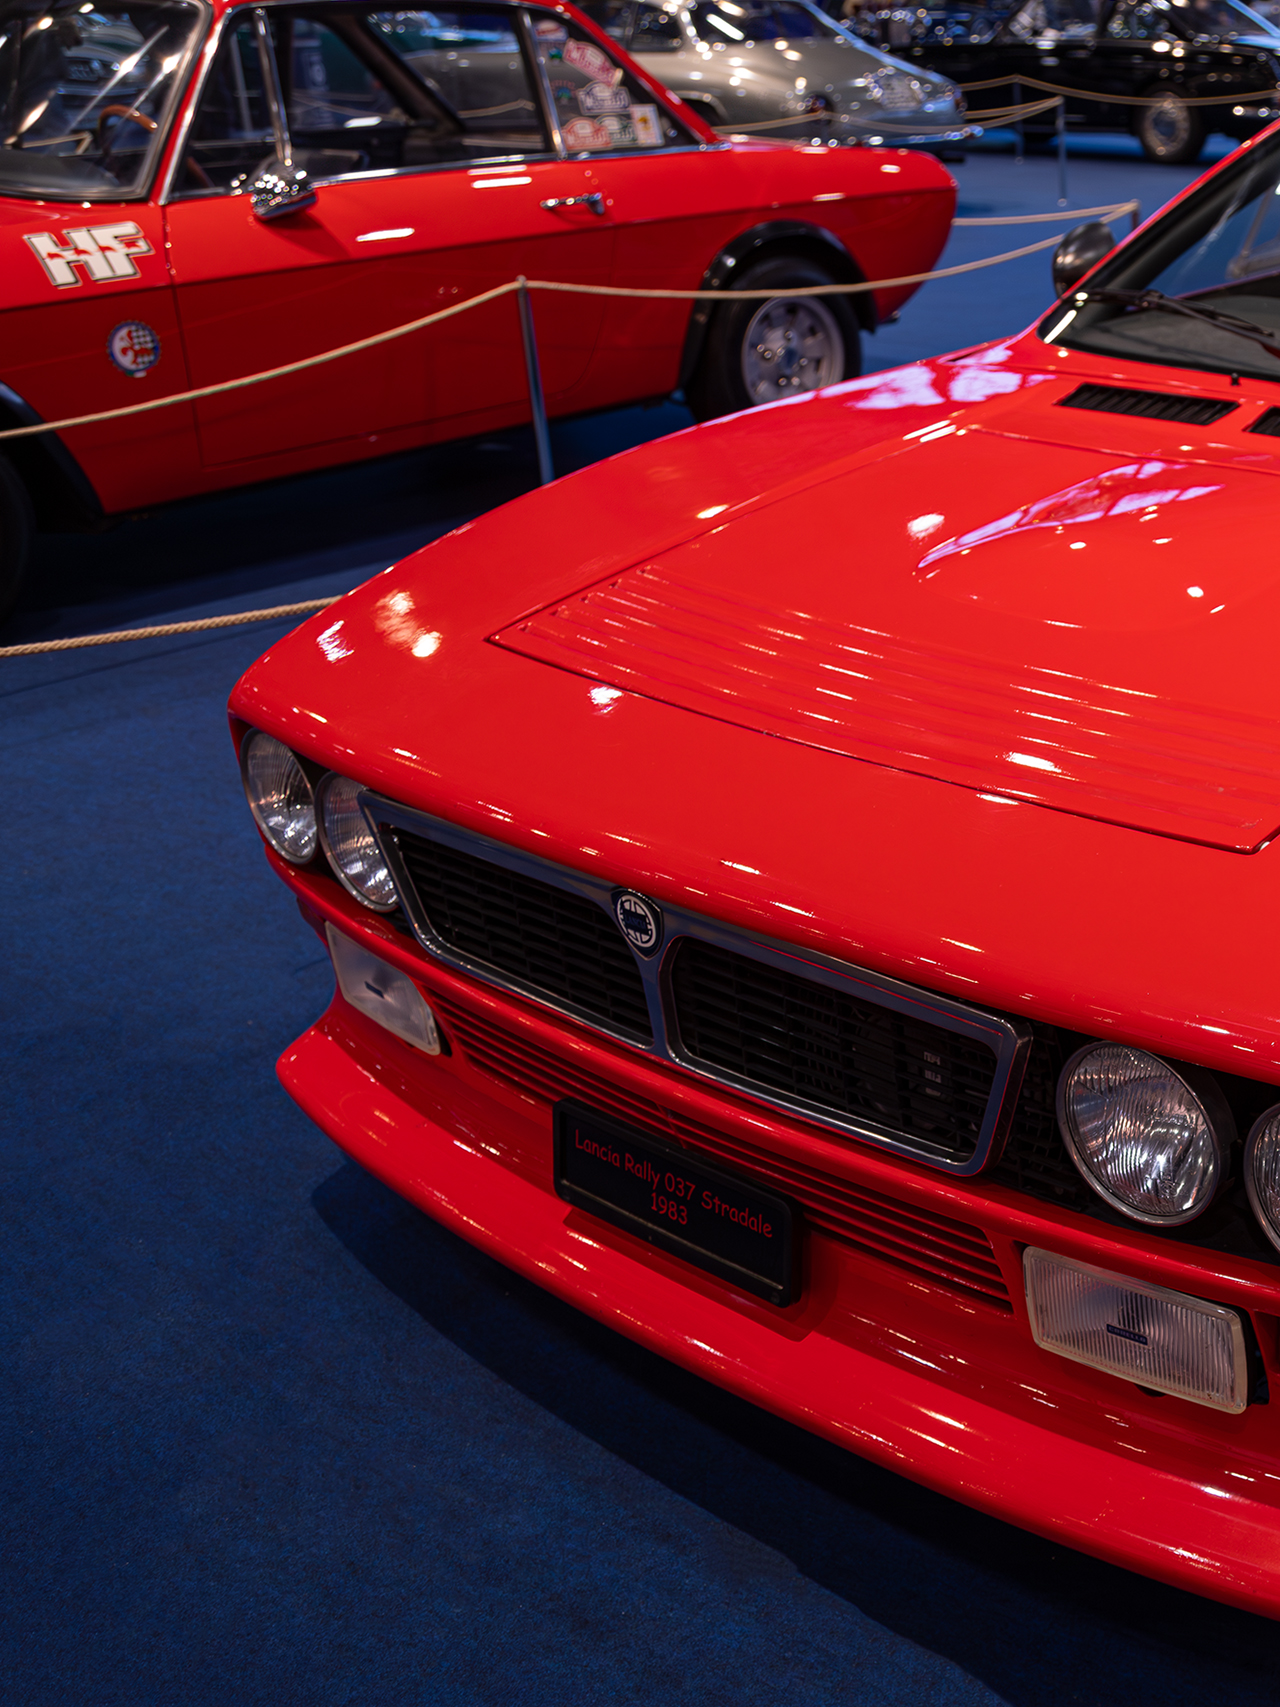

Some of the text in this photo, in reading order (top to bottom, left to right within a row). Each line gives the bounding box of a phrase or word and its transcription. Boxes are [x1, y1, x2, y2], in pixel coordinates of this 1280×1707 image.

[22, 220, 156, 290] HF
[575, 1128, 773, 1238] Lancia Rally 037 Stradale
[650, 1192, 689, 1225] 1983
